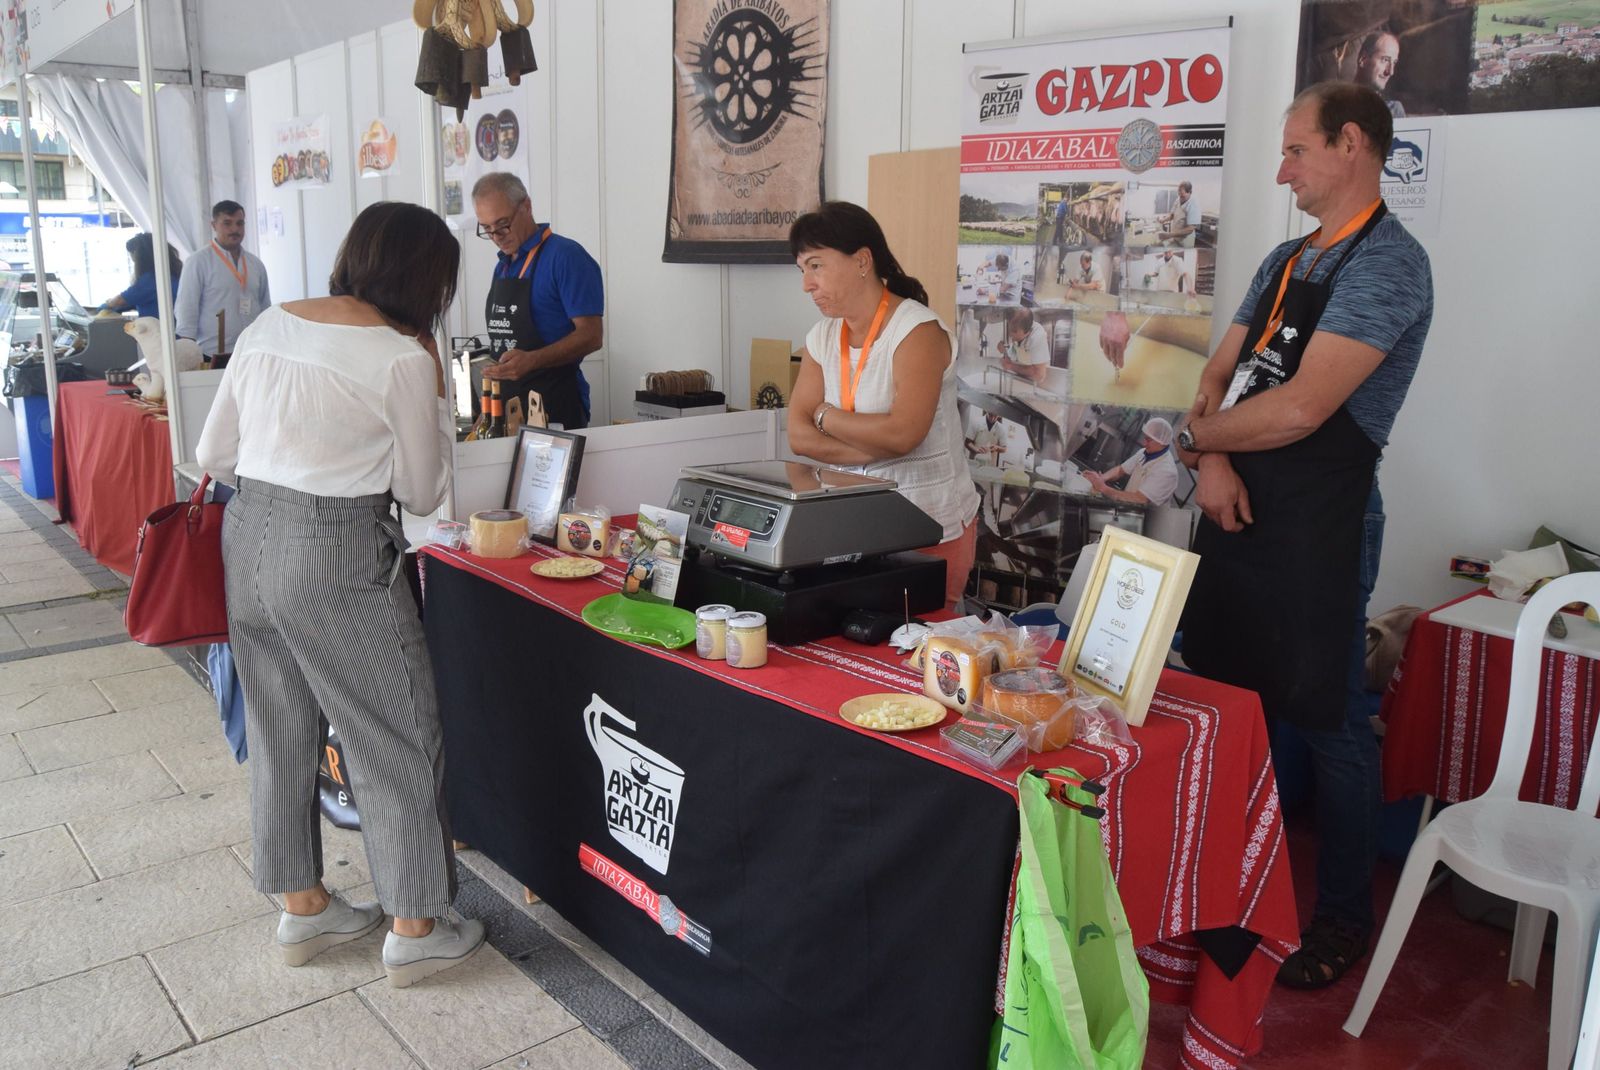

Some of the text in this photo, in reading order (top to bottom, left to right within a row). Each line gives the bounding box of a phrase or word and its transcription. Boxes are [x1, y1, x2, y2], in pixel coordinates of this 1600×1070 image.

[1035, 53, 1224, 116] GAZPIO
[981, 88, 1023, 106] ARTZAI
[980, 101, 1020, 119] GAZTA
[986, 137, 1112, 162] IDIAZABAL
[1166, 138, 1223, 150] BASERRIKOA
[1380, 185, 1428, 195] UESEROS
[1386, 196, 1427, 206] TESANOS
[607, 769, 674, 826] ARTZAI
[606, 795, 670, 851] GAZTA
[592, 857, 658, 912] IDIAZABAL
